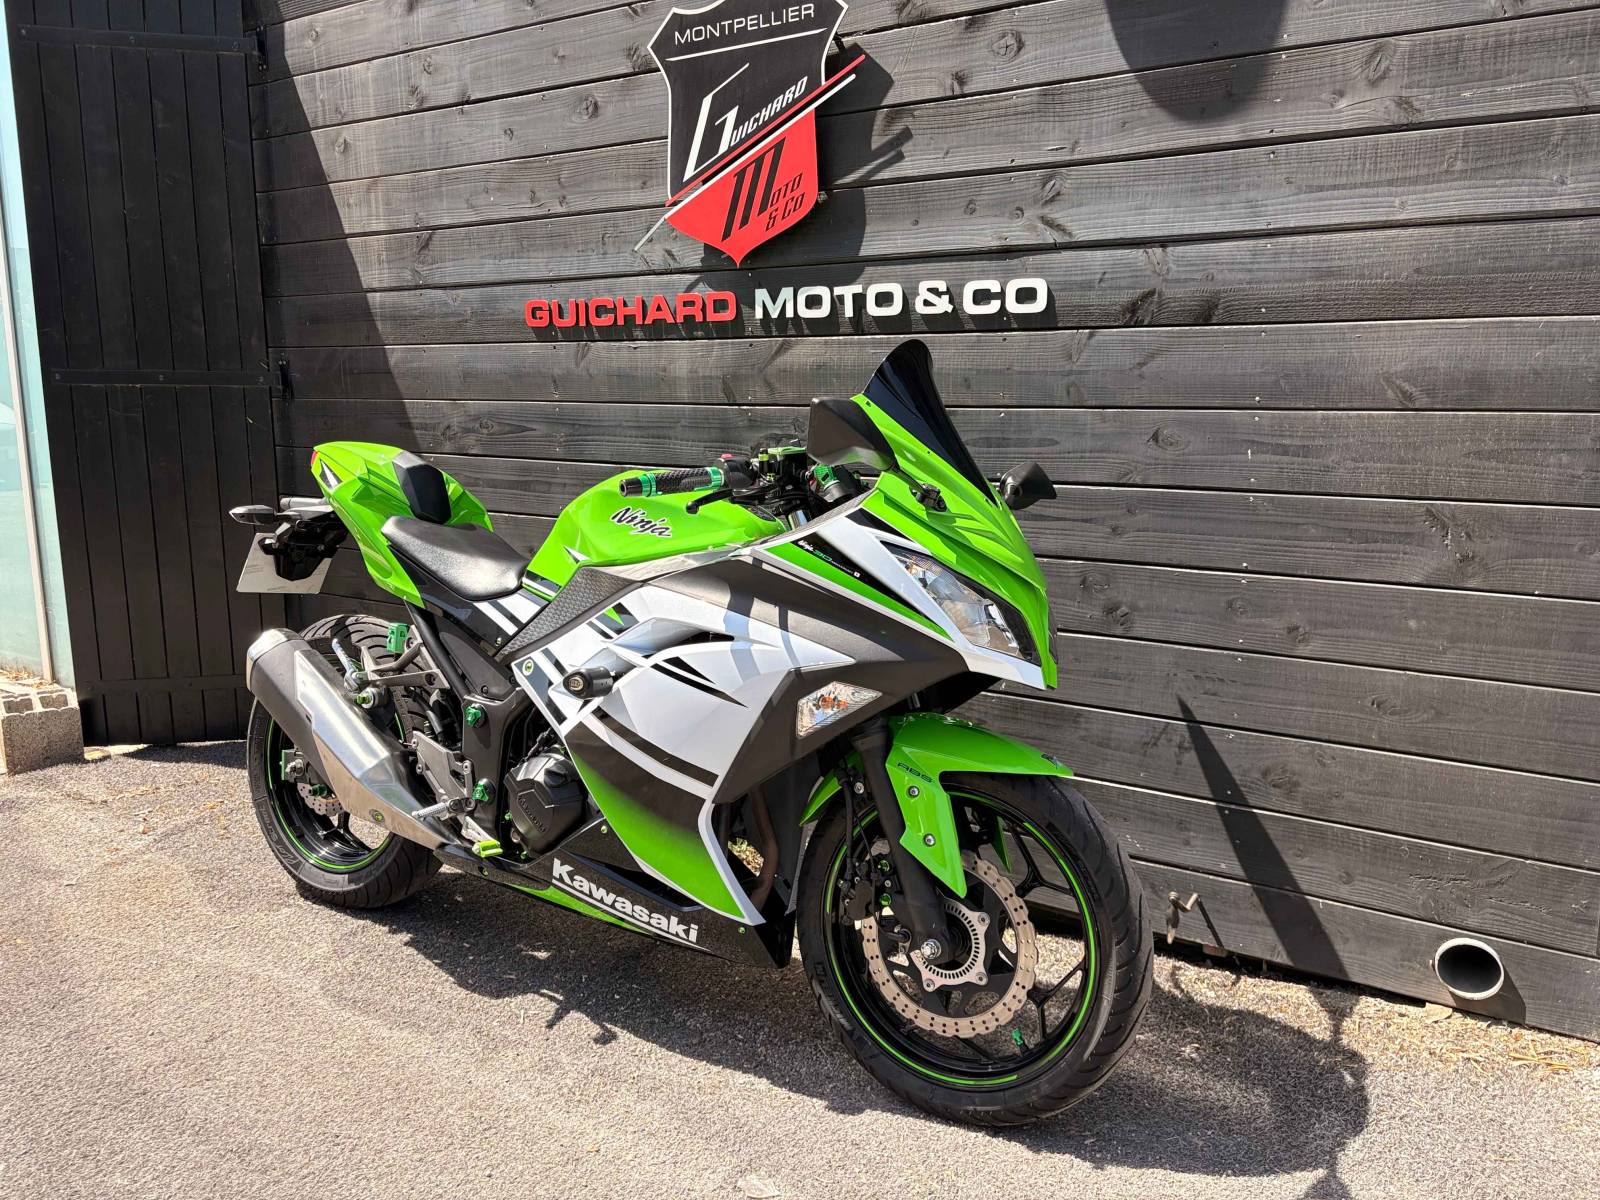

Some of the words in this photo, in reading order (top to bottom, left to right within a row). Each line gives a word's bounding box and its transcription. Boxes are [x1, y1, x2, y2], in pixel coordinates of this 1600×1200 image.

[674, 3, 815, 46] MONTPELLIER
[524, 290, 737, 328] GUICHARD
[754, 282, 903, 319] MOTO
[609, 506, 673, 538] Ninja
[552, 857, 699, 943] Kawasaki
